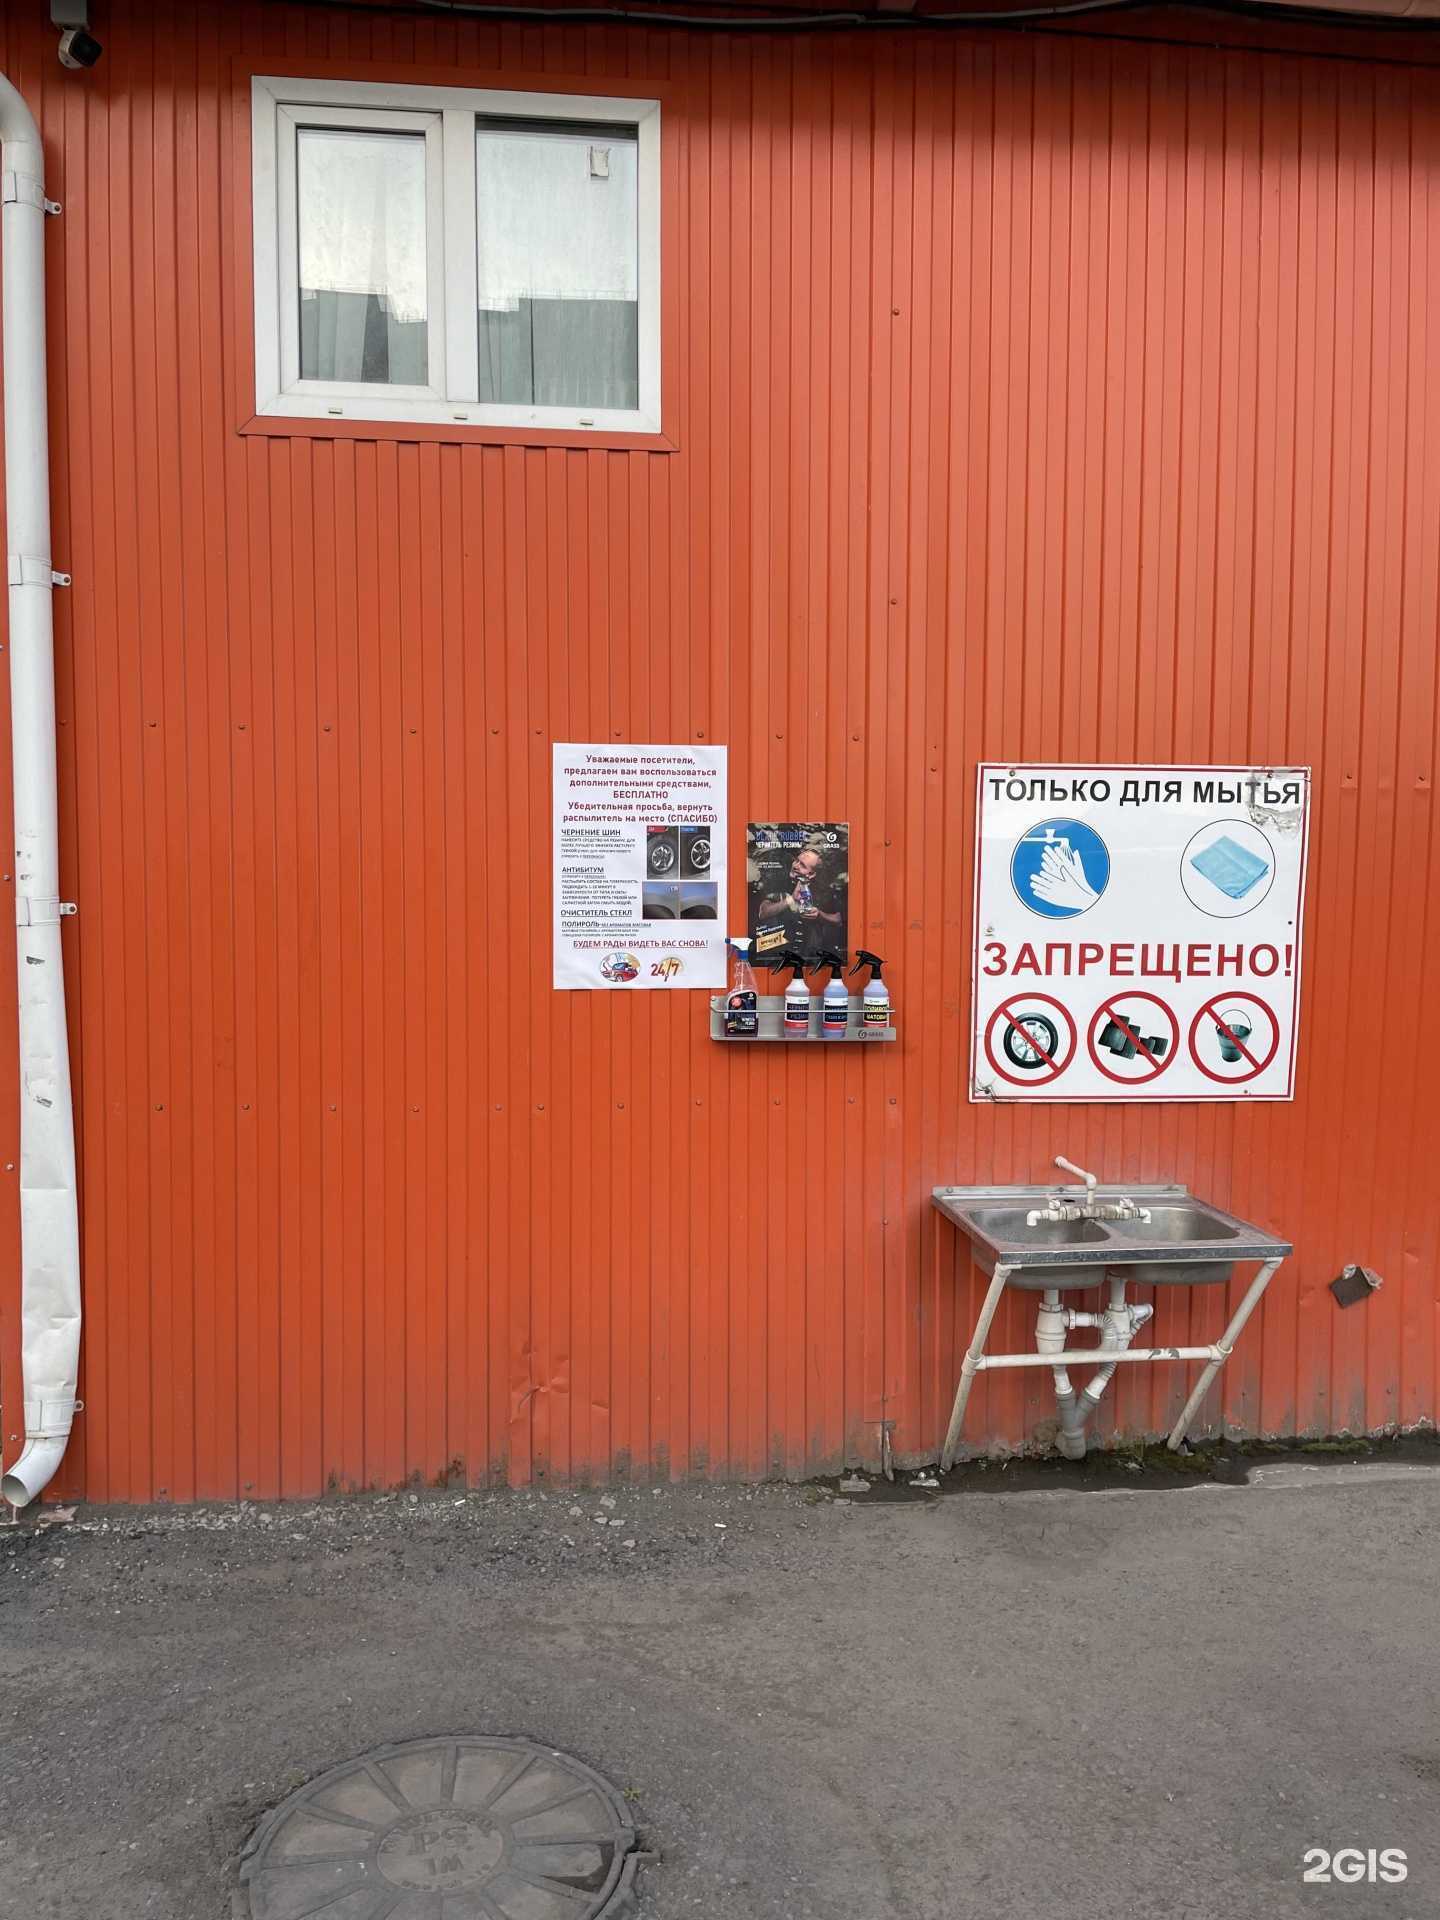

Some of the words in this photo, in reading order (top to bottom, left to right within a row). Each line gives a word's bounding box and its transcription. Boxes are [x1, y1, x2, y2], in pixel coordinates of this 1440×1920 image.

[586, 755, 638, 764] Уважаемые
[640, 756, 696, 765] посетители,
[564, 767, 618, 776] предлагаем
[639, 769, 717, 777] воспользоваться
[569, 779, 654, 788] дополнительными
[656, 780, 712, 789] средствами,
[613, 790, 669, 799] БЕСПЛАТНО
[989, 777, 1111, 803] ТОЛЬКО
[1119, 779, 1183, 806] ДЛЯ
[1193, 780, 1300, 805] МЫТЬЯ
[568, 802, 633, 811] Убедительная
[635, 803, 675, 812] просьба,
[677, 804, 713, 813] вернуть
[563, 814, 623, 823] распылитель
[667, 814, 718, 823] (СПАСИБО)
[560, 909, 609, 917] ОЧИСТИТЕЛЬ
[609, 909, 632, 917] СТЕКЛ
[573, 940, 601, 948] БУДЕМ
[603, 940, 627, 948] РАДЫ
[629, 940, 660, 948] ВИДЕТЬ
[983, 942, 1293, 983] ЗАПРЕЩЕНО!
